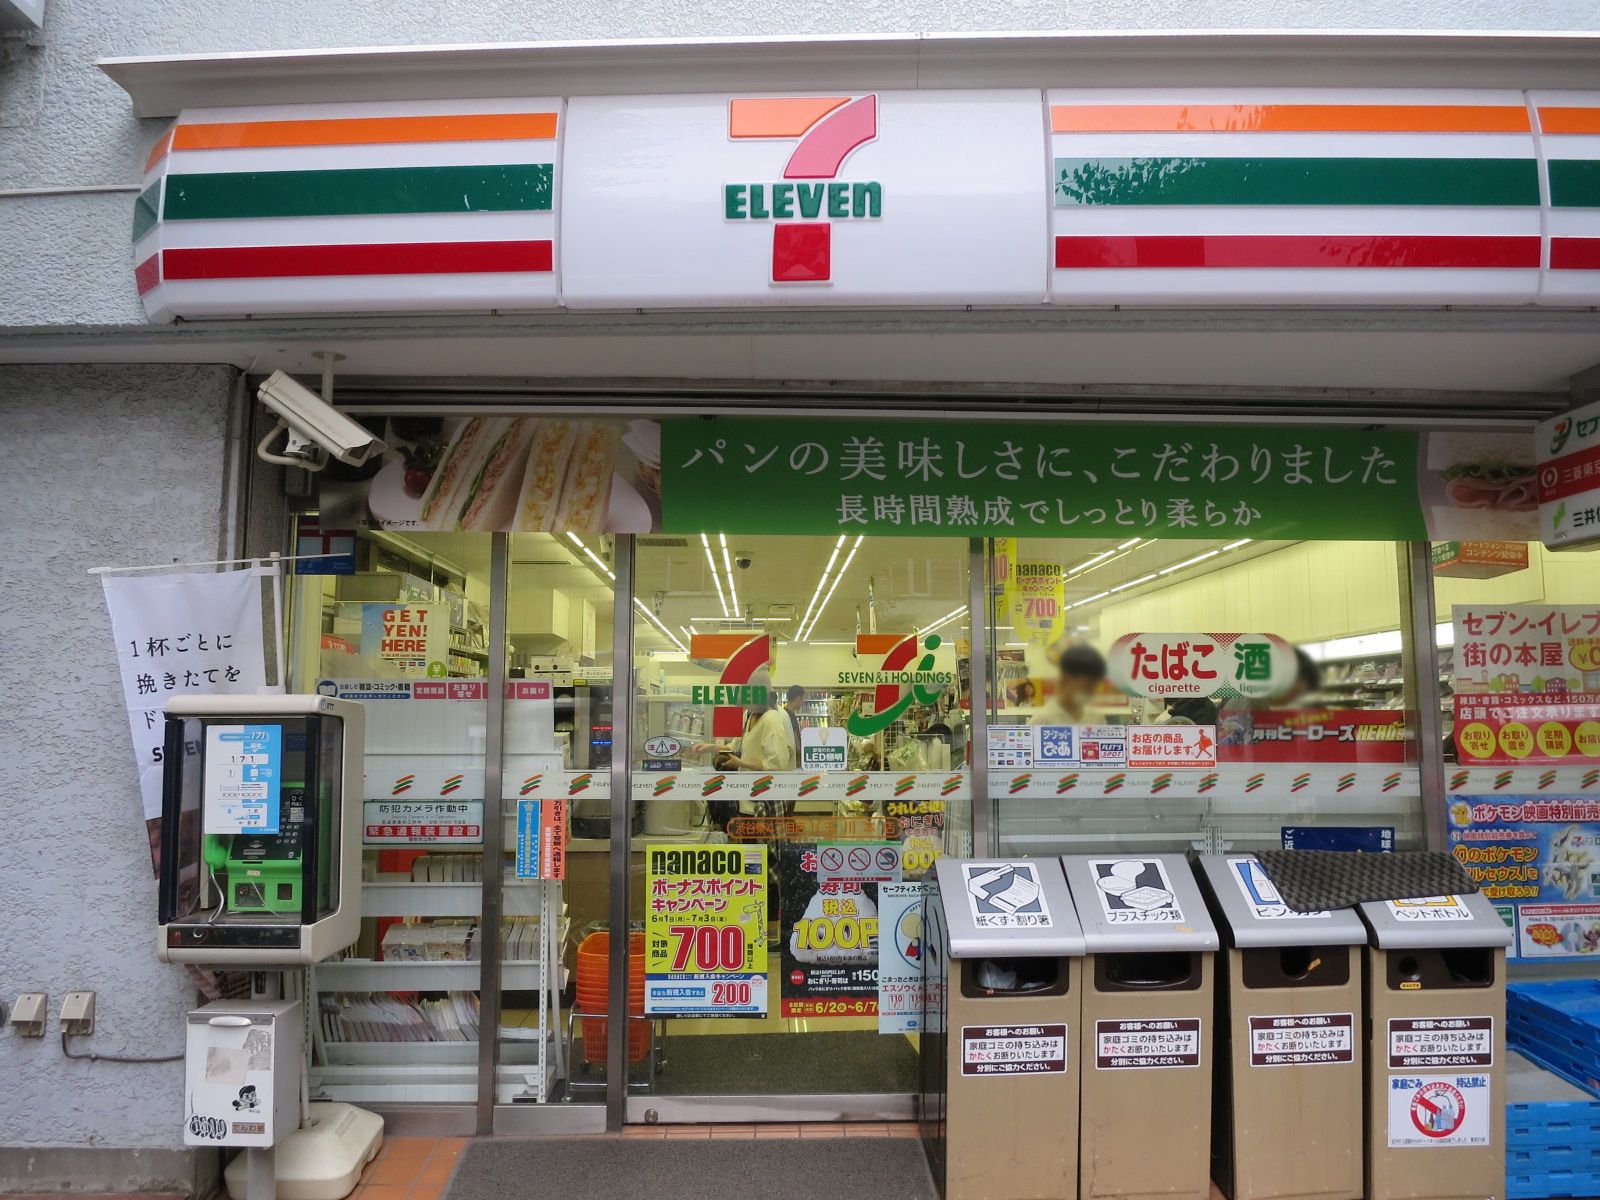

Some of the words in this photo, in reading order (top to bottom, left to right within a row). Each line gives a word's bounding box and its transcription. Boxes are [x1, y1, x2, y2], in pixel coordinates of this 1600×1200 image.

[681, 436, 1397, 484] パンの美味しさに、こだわりました
[835, 494, 1262, 529] 長時間熟成でしっとり柔らか
[1022, 598, 1057, 618] 700
[383, 609, 428, 623] GET
[383, 624, 428, 637] YEN!
[129, 632, 234, 659] 1杯ごとに
[381, 639, 427, 652] HERE
[1463, 641, 1564, 668] 街の本屋
[1130, 640, 1217, 680] たばこ
[1234, 642, 1272, 681] 酒
[136, 666, 242, 695] 挽きたてを
[890, 671, 952, 684] HOLDINGS
[457, 690, 473, 698] 寄せ
[522, 686, 545, 695] お届け
[1148, 682, 1201, 695] cigarette
[1043, 730, 1071, 739] チケット
[1131, 733, 1183, 743] お店の商品
[1543, 730, 1563, 741] 定期
[1043, 741, 1071, 756] ぴあ
[1131, 745, 1195, 756] お届けします。
[805, 753, 843, 762] LED照明
[378, 802, 468, 813] 防犯カメラ作動中
[651, 849, 742, 876] nanaco
[651, 878, 764, 896] ボーナスポイント
[651, 897, 729, 914] キャンペーン
[822, 898, 858, 916] 税込
[1107, 909, 1184, 922] プラスチック類
[1395, 907, 1469, 919] ペットボトル
[651, 949, 668, 958] 商品
[669, 924, 745, 972] 700
[712, 981, 752, 1005] 200
[1119, 1021, 1178, 1031] お客様へのお願い
[1272, 1016, 1332, 1027] お客様へのお願い
[1411, 1019, 1471, 1030] お客様へのお願い
[985, 1027, 1045, 1037] お客様へのお願い
[1257, 1029, 1345, 1041] 家庭ゴミの持ち込みは
[1395, 1032, 1484, 1043] 家庭ゴミの持ち込みは
[1103, 1033, 1192, 1044] 家庭ゴミの持ち込みは
[968, 1039, 1059, 1050] 家庭ゴミの持ち込みは
[1103, 1043, 1194, 1054] かたくお断りいたします。
[1257, 1040, 1347, 1051] かたくお断りいたします。
[1395, 1043, 1486, 1053] かたくお断りいたします。
[968, 1049, 1060, 1060] かたくお断りいたします。
[1264, 1052, 1340, 1064] 分別にご協力ください。
[1402, 1054, 1478, 1065] 分別にご協力ください。
[1110, 1055, 1184, 1066] 分別にご協力ください。
[976, 1061, 1051, 1073] 分別にご協力ください。
[1391, 1078, 1423, 1089] 家庭ごみ
[1455, 1077, 1487, 1088] 持込禁止
